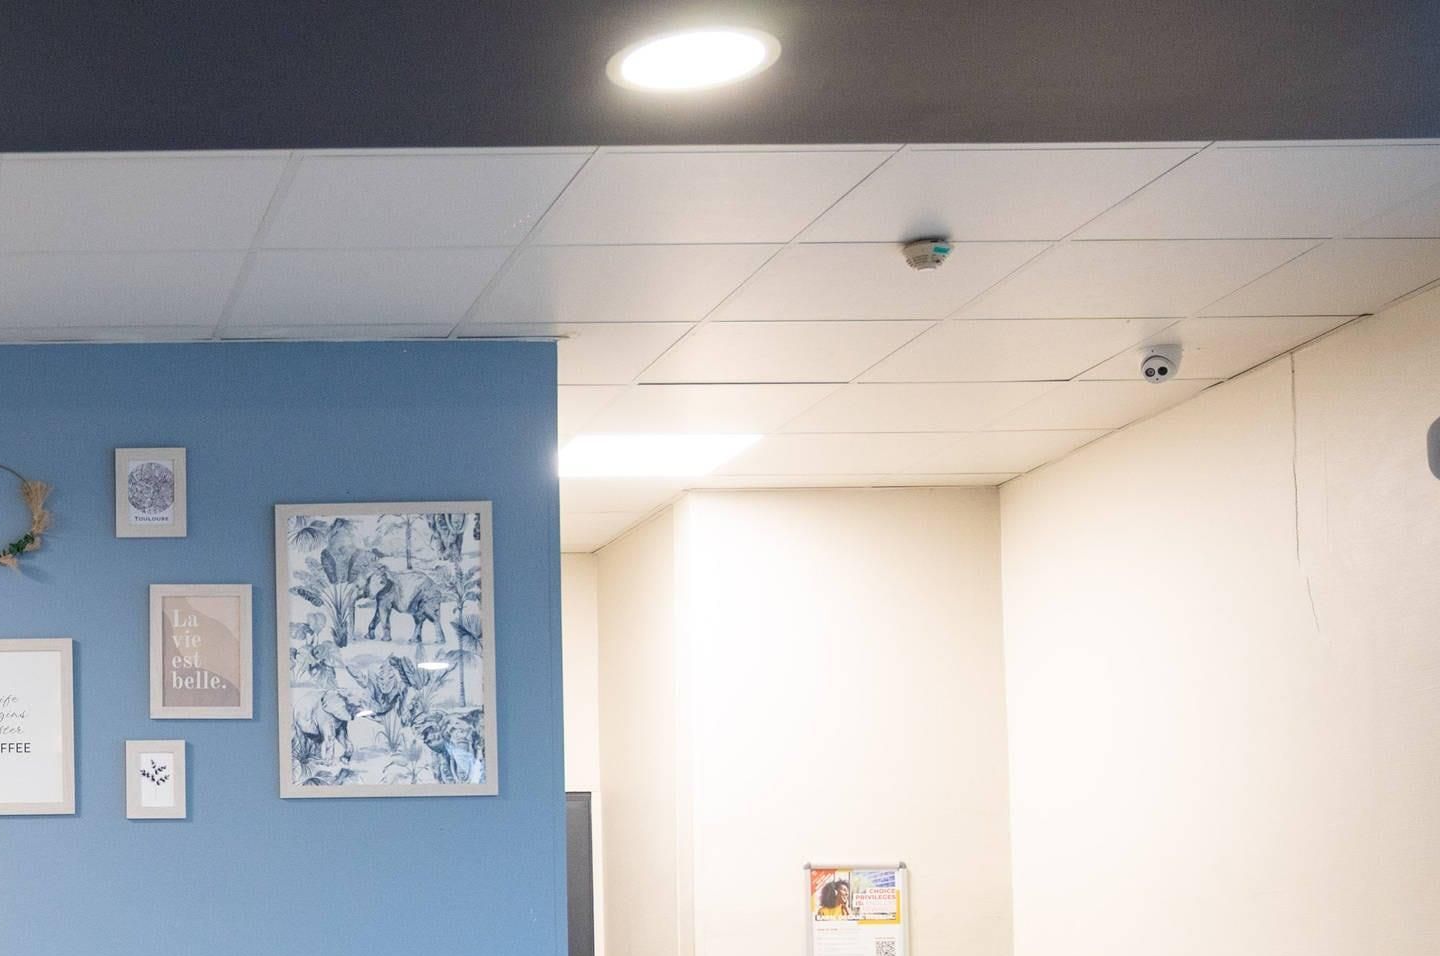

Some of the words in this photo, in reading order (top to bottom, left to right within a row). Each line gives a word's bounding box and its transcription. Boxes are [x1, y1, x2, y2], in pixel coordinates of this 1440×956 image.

[172, 609, 199, 628] La
[172, 630, 201, 648] vie
[172, 651, 202, 668] est
[172, 671, 227, 689] belle.
